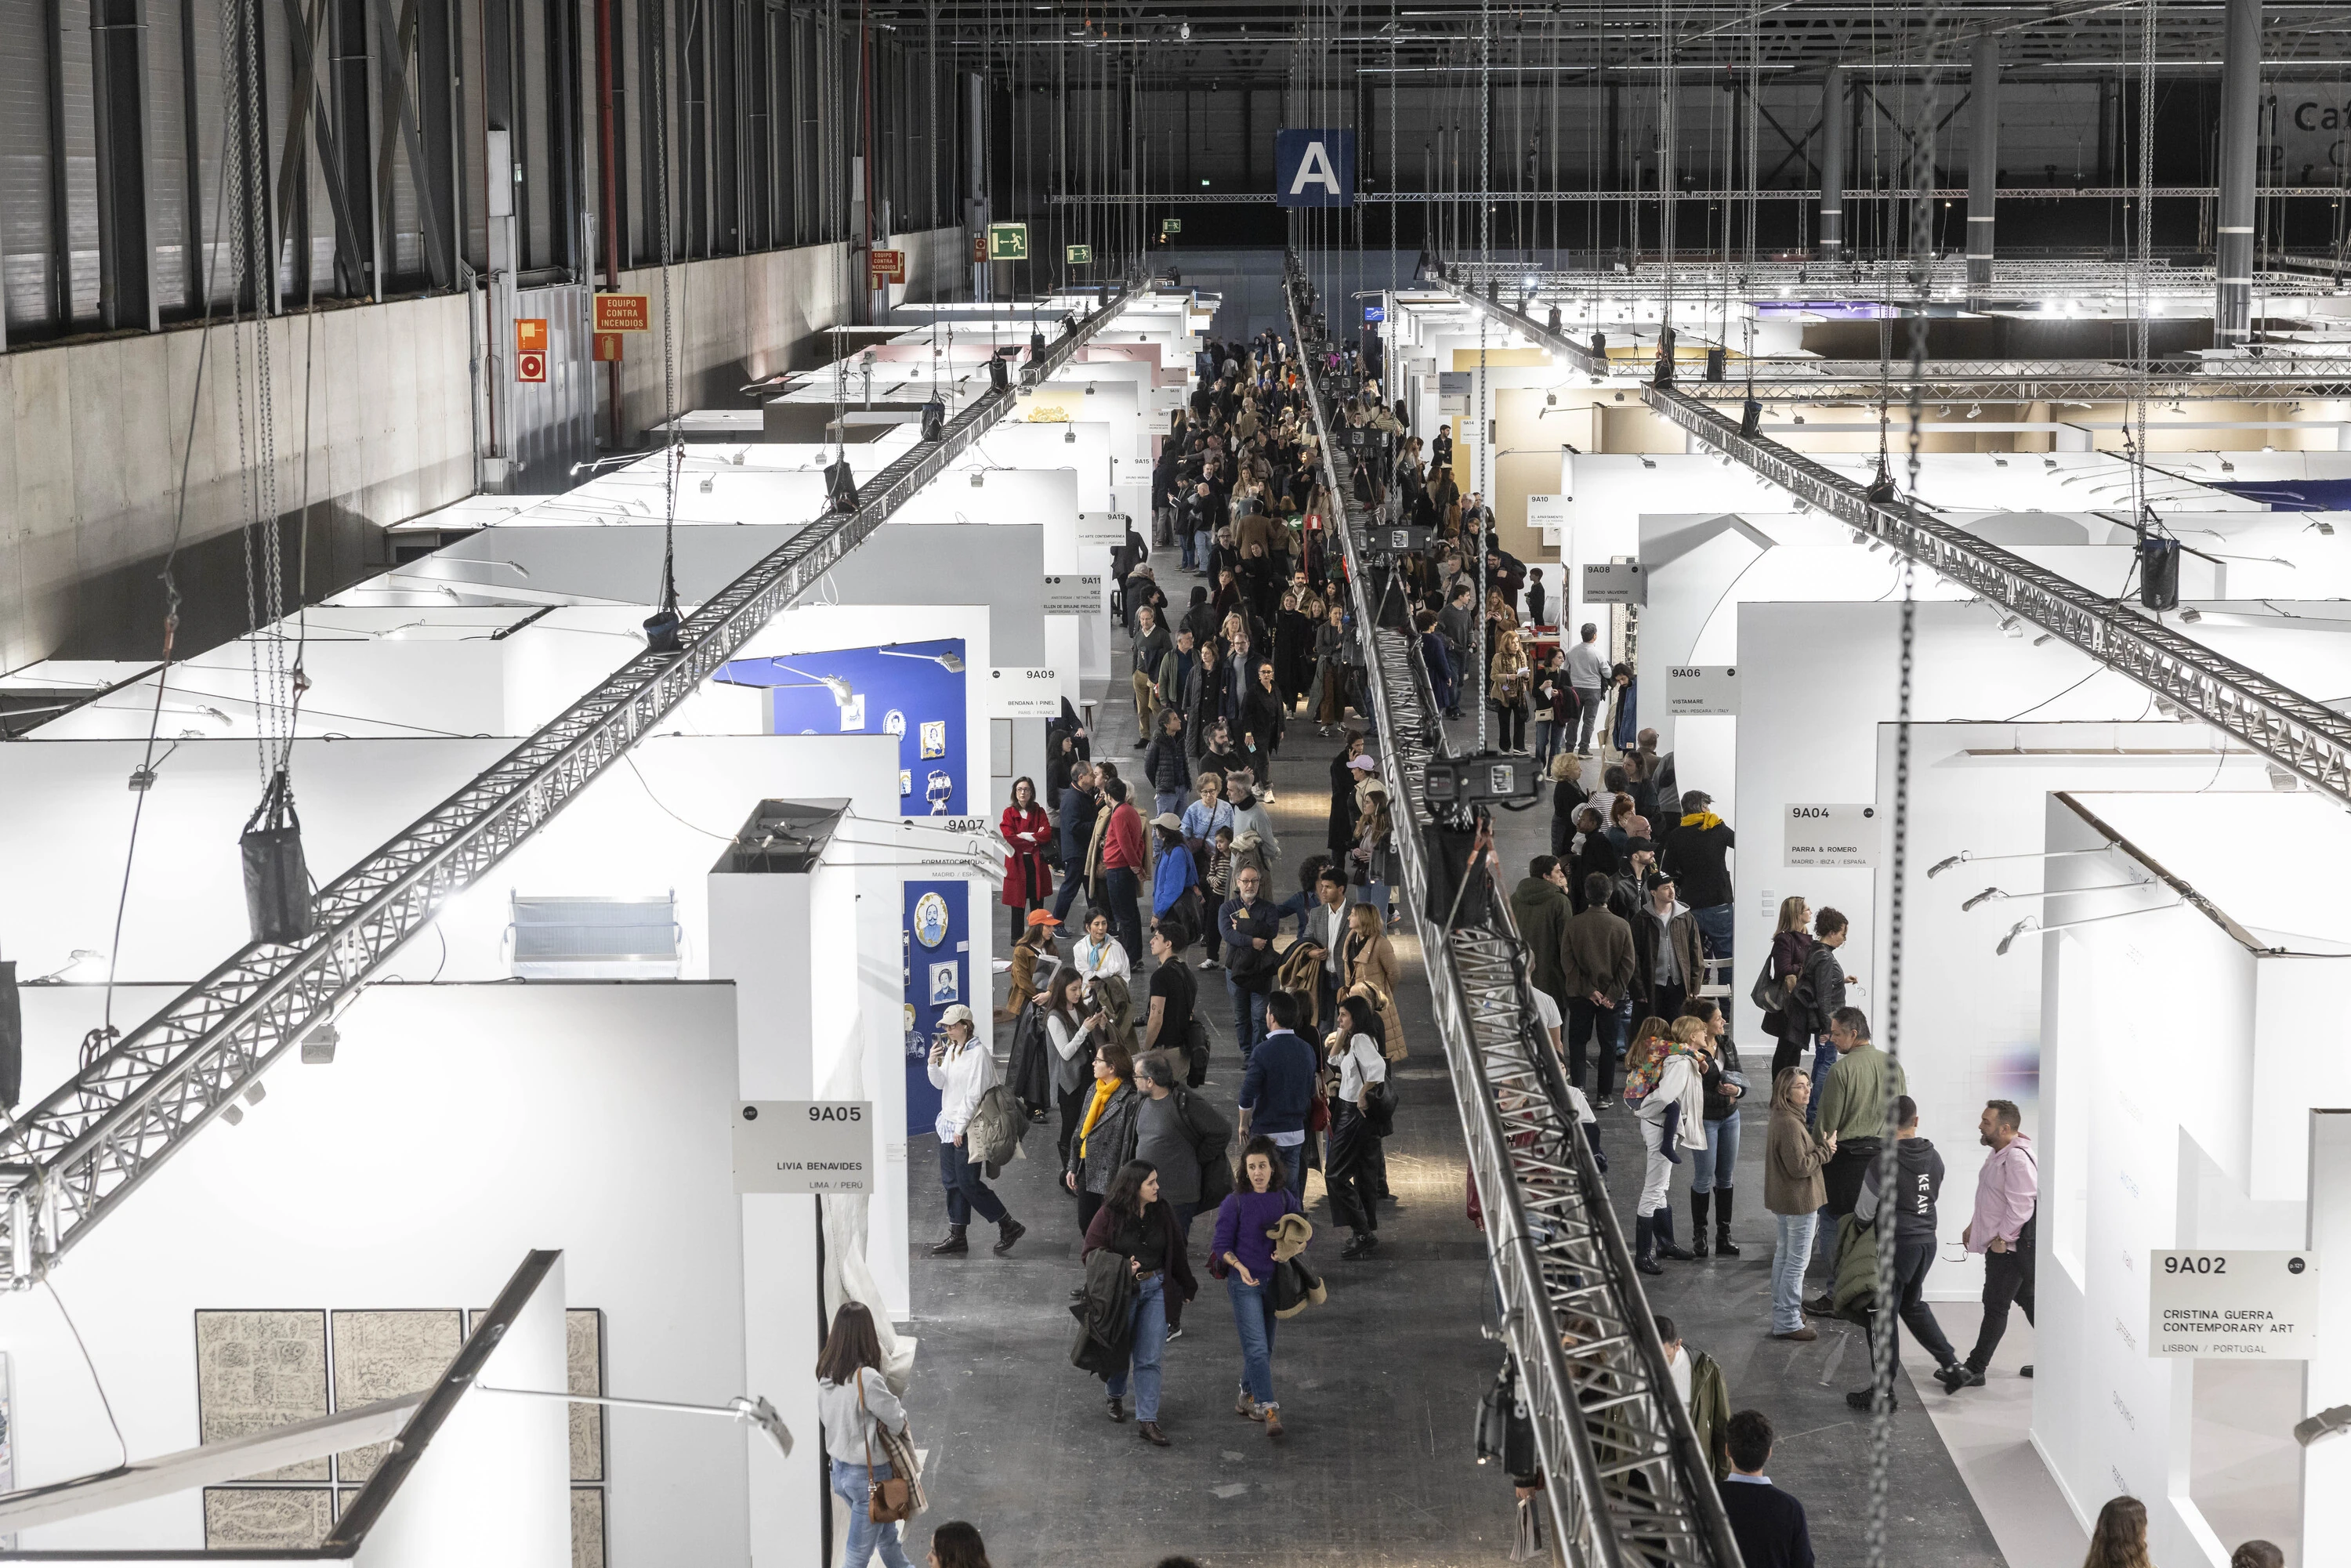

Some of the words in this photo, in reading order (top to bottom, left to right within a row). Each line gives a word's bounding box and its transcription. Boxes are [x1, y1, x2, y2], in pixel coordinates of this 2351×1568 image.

[1289, 142, 1341, 194] A
[1027, 670, 1055, 679] 9A09
[1672, 668, 1701, 677] 9A06
[1792, 807, 1830, 818] 9A04
[947, 820, 984, 831] 9A07
[809, 1106, 861, 1121] 9A05
[777, 1162, 802, 1171] LIVIA
[806, 1162, 862, 1171] BENAVIDES
[1917, 1194, 1929, 1215] AIR
[2164, 1257, 2226, 1274] 9A02
[2163, 1310, 2219, 1319] CRISTINA
[2224, 1310, 2274, 1320] GUERRA
[2163, 1323, 2263, 1333] CONTEMPORARY
[2270, 1324, 2295, 1333] ART
[2162, 1344, 2199, 1353] LISBON
[2213, 1345, 2267, 1353] PORTUGAL
